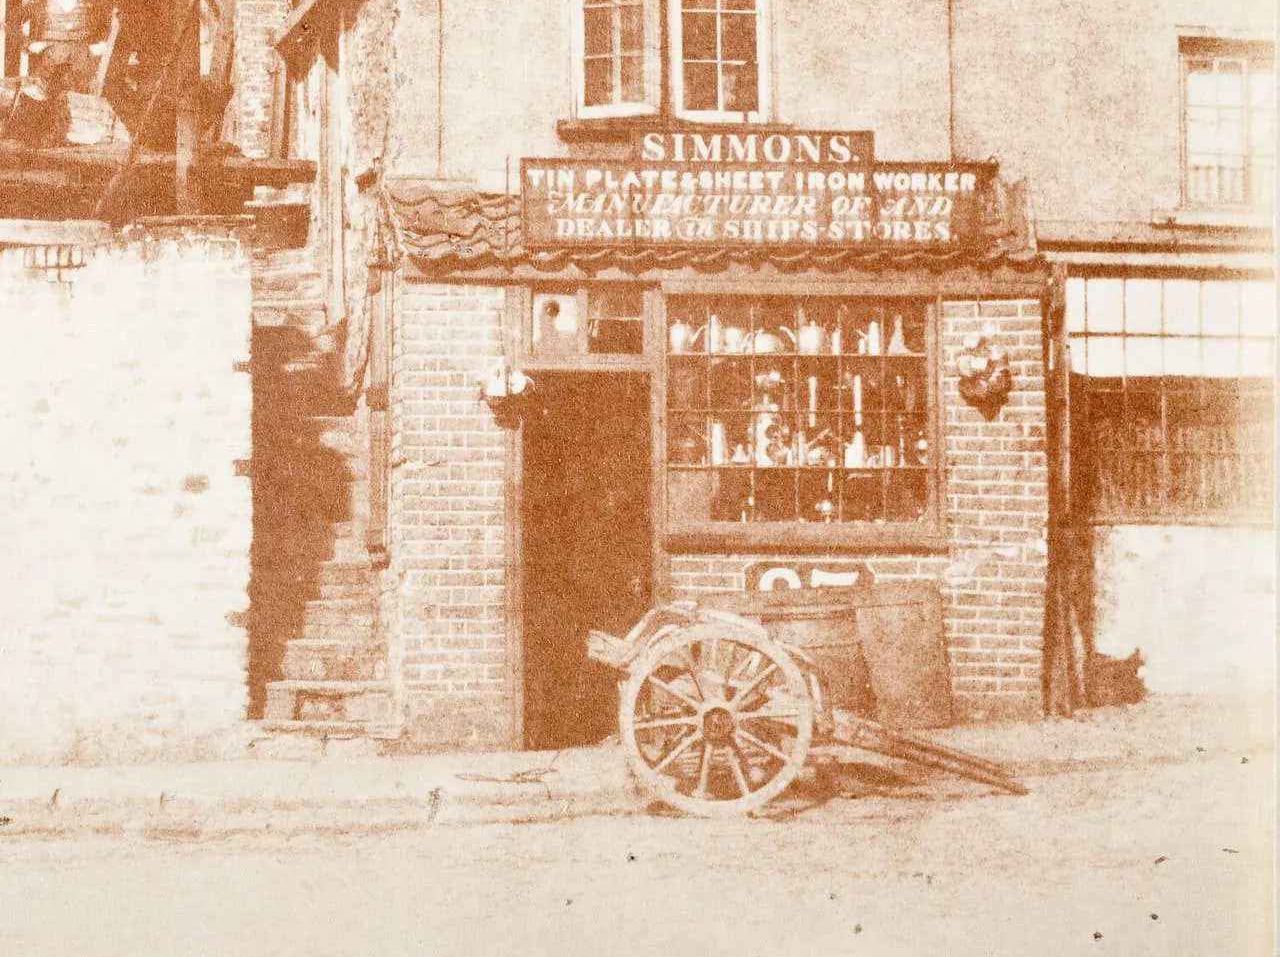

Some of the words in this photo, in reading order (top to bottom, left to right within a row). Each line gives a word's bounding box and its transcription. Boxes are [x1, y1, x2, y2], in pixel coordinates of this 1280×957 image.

[641, 132, 860, 163] SIMMONS.
[526, 168, 575, 189] TIN
[795, 171, 865, 191] IRON
[873, 171, 977, 193] WORKER
[547, 192, 817, 215] MANUFACTURER
[831, 195, 872, 216] OF
[880, 195, 953, 217] AND
[556, 218, 672, 239] DEALER
